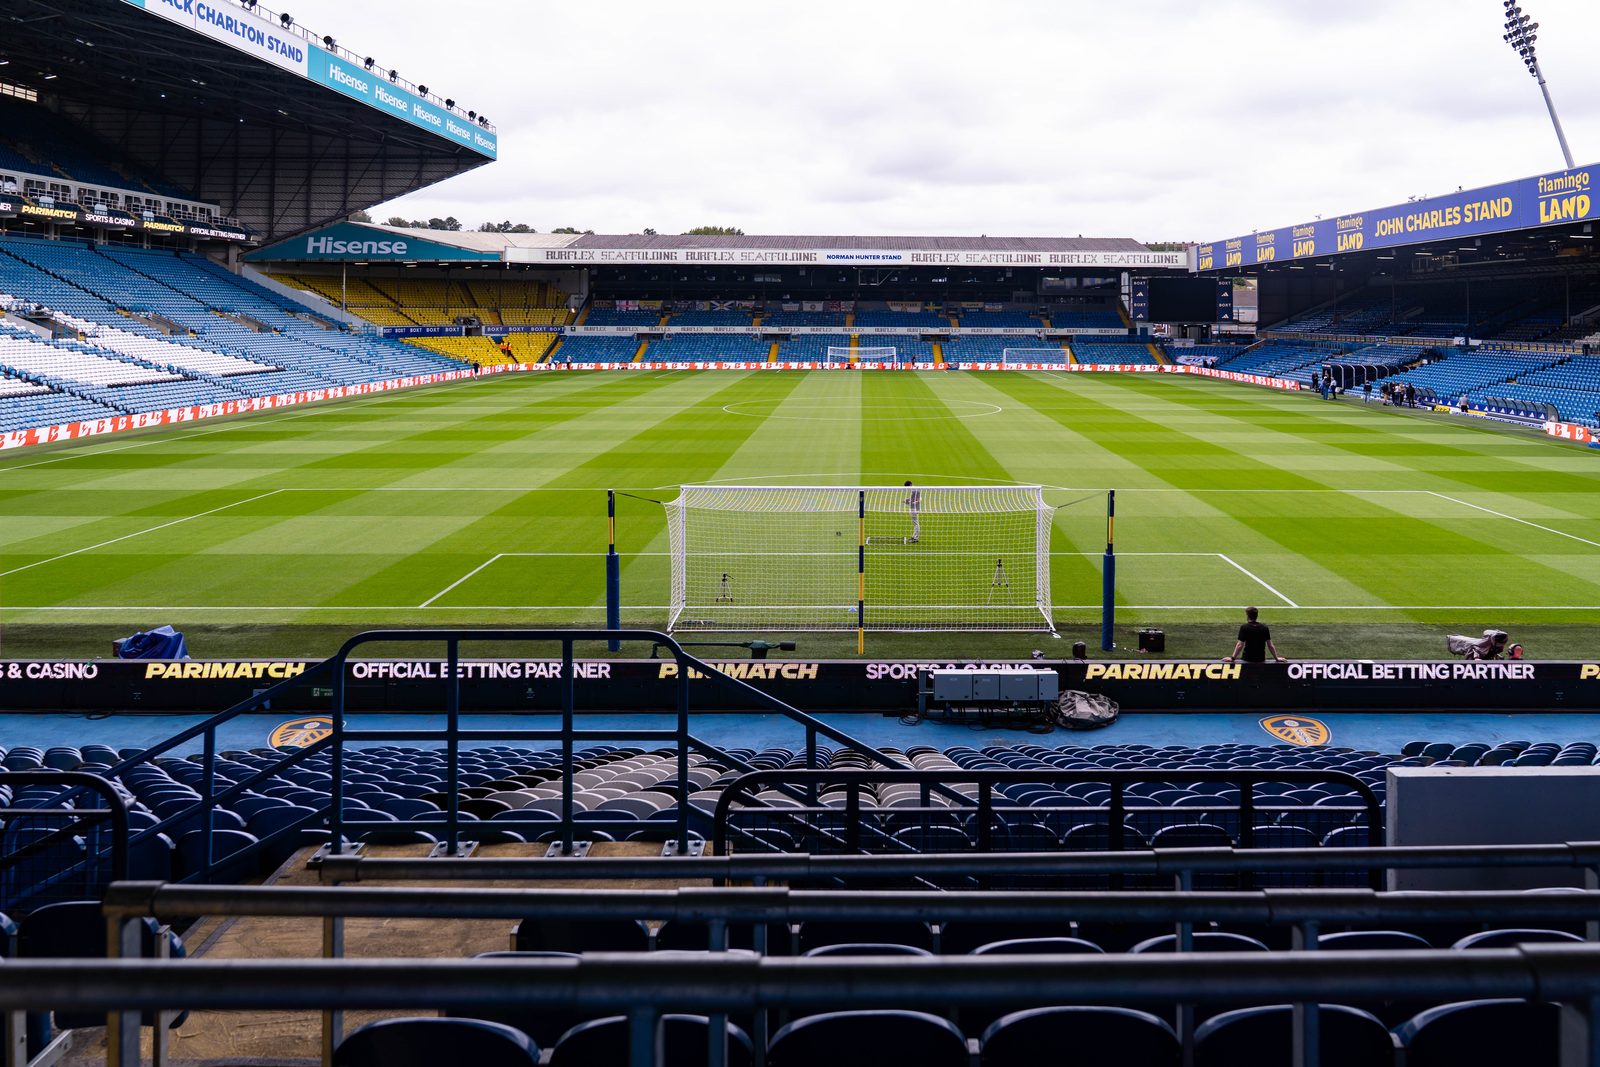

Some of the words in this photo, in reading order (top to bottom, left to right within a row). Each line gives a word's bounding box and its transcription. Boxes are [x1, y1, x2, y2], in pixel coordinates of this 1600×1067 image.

[197, 3, 264, 47] CHARLTON
[268, 36, 303, 63] STAND
[330, 64, 368, 94] Hisense
[375, 85, 408, 112] Hisense
[414, 104, 442, 128] Hisense
[446, 119, 470, 140] Hisense
[474, 132, 496, 152] Hisense
[1538, 171, 1590, 192] flamingo
[22, 205, 77, 220] PARIMATCH
[1375, 217, 1403, 238] JOHN
[1406, 206, 1461, 232] CHARLES
[1464, 197, 1512, 223] STAND
[1539, 194, 1590, 224] LAND
[86, 214, 108, 224] SPORTS
[114, 218, 135, 226] CASINO
[144, 222, 184, 232] PARIMATCH
[1337, 216, 1362, 230] flamingo
[190, 227, 210, 236] OFFICIAL
[306, 236, 407, 254] Hisense
[1293, 240, 1315, 258] LAND
[1337, 232, 1363, 252] LAND
[601, 251, 678, 260] SCAFFOLDING
[741, 252, 816, 261] SCAFFOLDING
[966, 254, 1042, 263] SCAFFOLDING
[1104, 254, 1178, 264] SCAFFOLDING
[1257, 247, 1275, 262] LAND
[7, 663, 22, 679] &
[26, 663, 98, 679] CASINO
[144, 662, 306, 678] PARIMATCH
[352, 662, 436, 678] OFFICIAL
[525, 662, 610, 678] PARNER
[1086, 664, 1242, 680] PARIMATCH
[1288, 664, 1368, 680] OFFICIAL
[1372, 664, 1450, 679] BETTING
[1453, 664, 1535, 679] PARTNER
